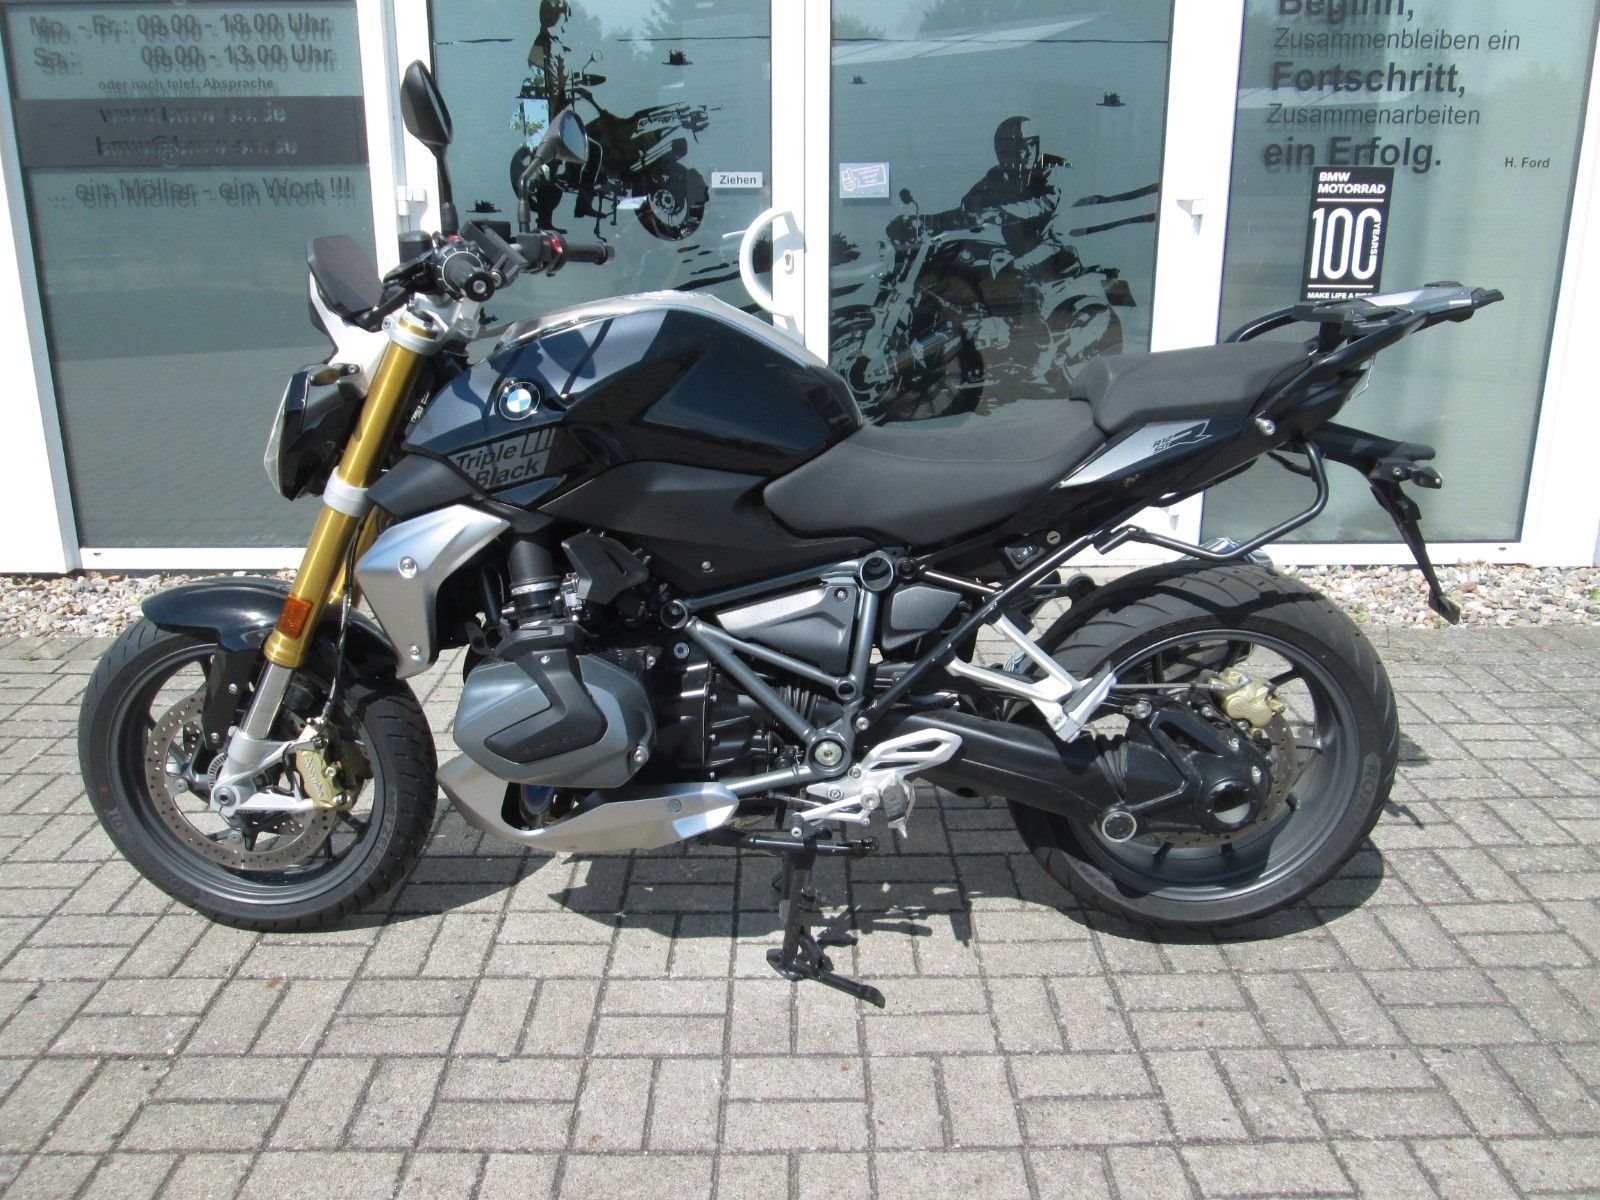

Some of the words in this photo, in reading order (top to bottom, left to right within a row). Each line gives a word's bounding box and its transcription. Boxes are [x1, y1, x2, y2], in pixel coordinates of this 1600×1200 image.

[288, 12, 331, 34] Uhr
[1273, 28, 1480, 50] Zusammenbleiben
[1487, 29, 1521, 50] ein
[291, 44, 334, 65] Uhr
[98, 80, 128, 91] oder
[132, 79, 164, 91] nach
[203, 77, 274, 92] Absprache
[1271, 61, 1466, 98] Fortschritt,
[1266, 103, 1481, 126] Zusammenarbeiten
[1264, 136, 1316, 167] ein
[1328, 136, 1442, 174] Erfolg.
[1504, 158, 1517, 168] H.
[1521, 157, 1551, 169] Ford
[719, 175, 757, 185] Ziehen
[1319, 171, 1351, 182] BMW
[219, 177, 257, 201] ein
[263, 177, 325, 201] Wort
[1317, 183, 1386, 194] MOTORRAD
[1309, 207, 1382, 280] 100
[1370, 222, 1382, 256] YEARS
[1307, 291, 1330, 299] MAKE
[1331, 291, 1347, 299] LIFE
[1347, 291, 1354, 299] A
[457, 443, 517, 470] Triple
[475, 457, 541, 487] Black
